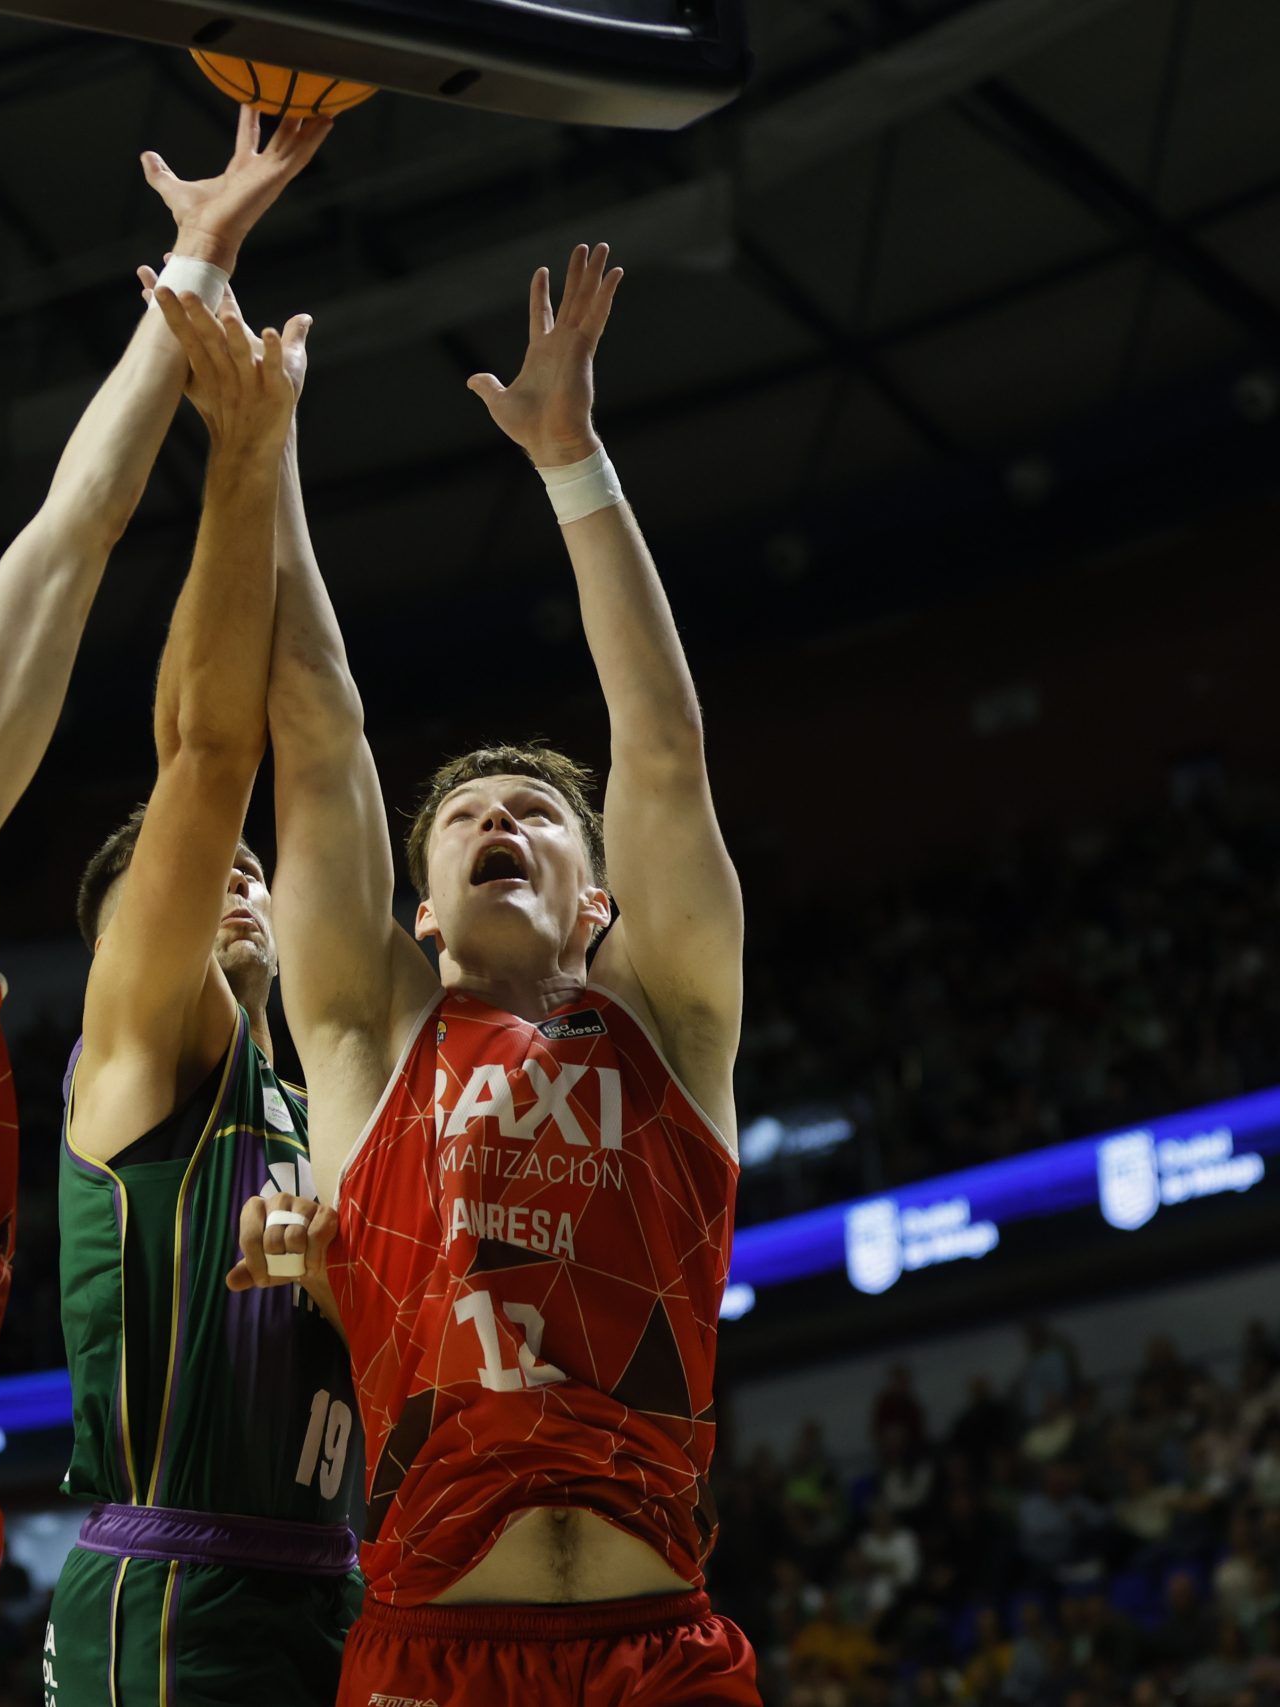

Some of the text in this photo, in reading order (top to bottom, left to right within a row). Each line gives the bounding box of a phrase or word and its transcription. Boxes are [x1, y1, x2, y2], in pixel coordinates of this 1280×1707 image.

[445, 1197, 576, 1262] ANRESA
[454, 1290, 567, 1392] 12
[295, 1388, 352, 1500] 19
